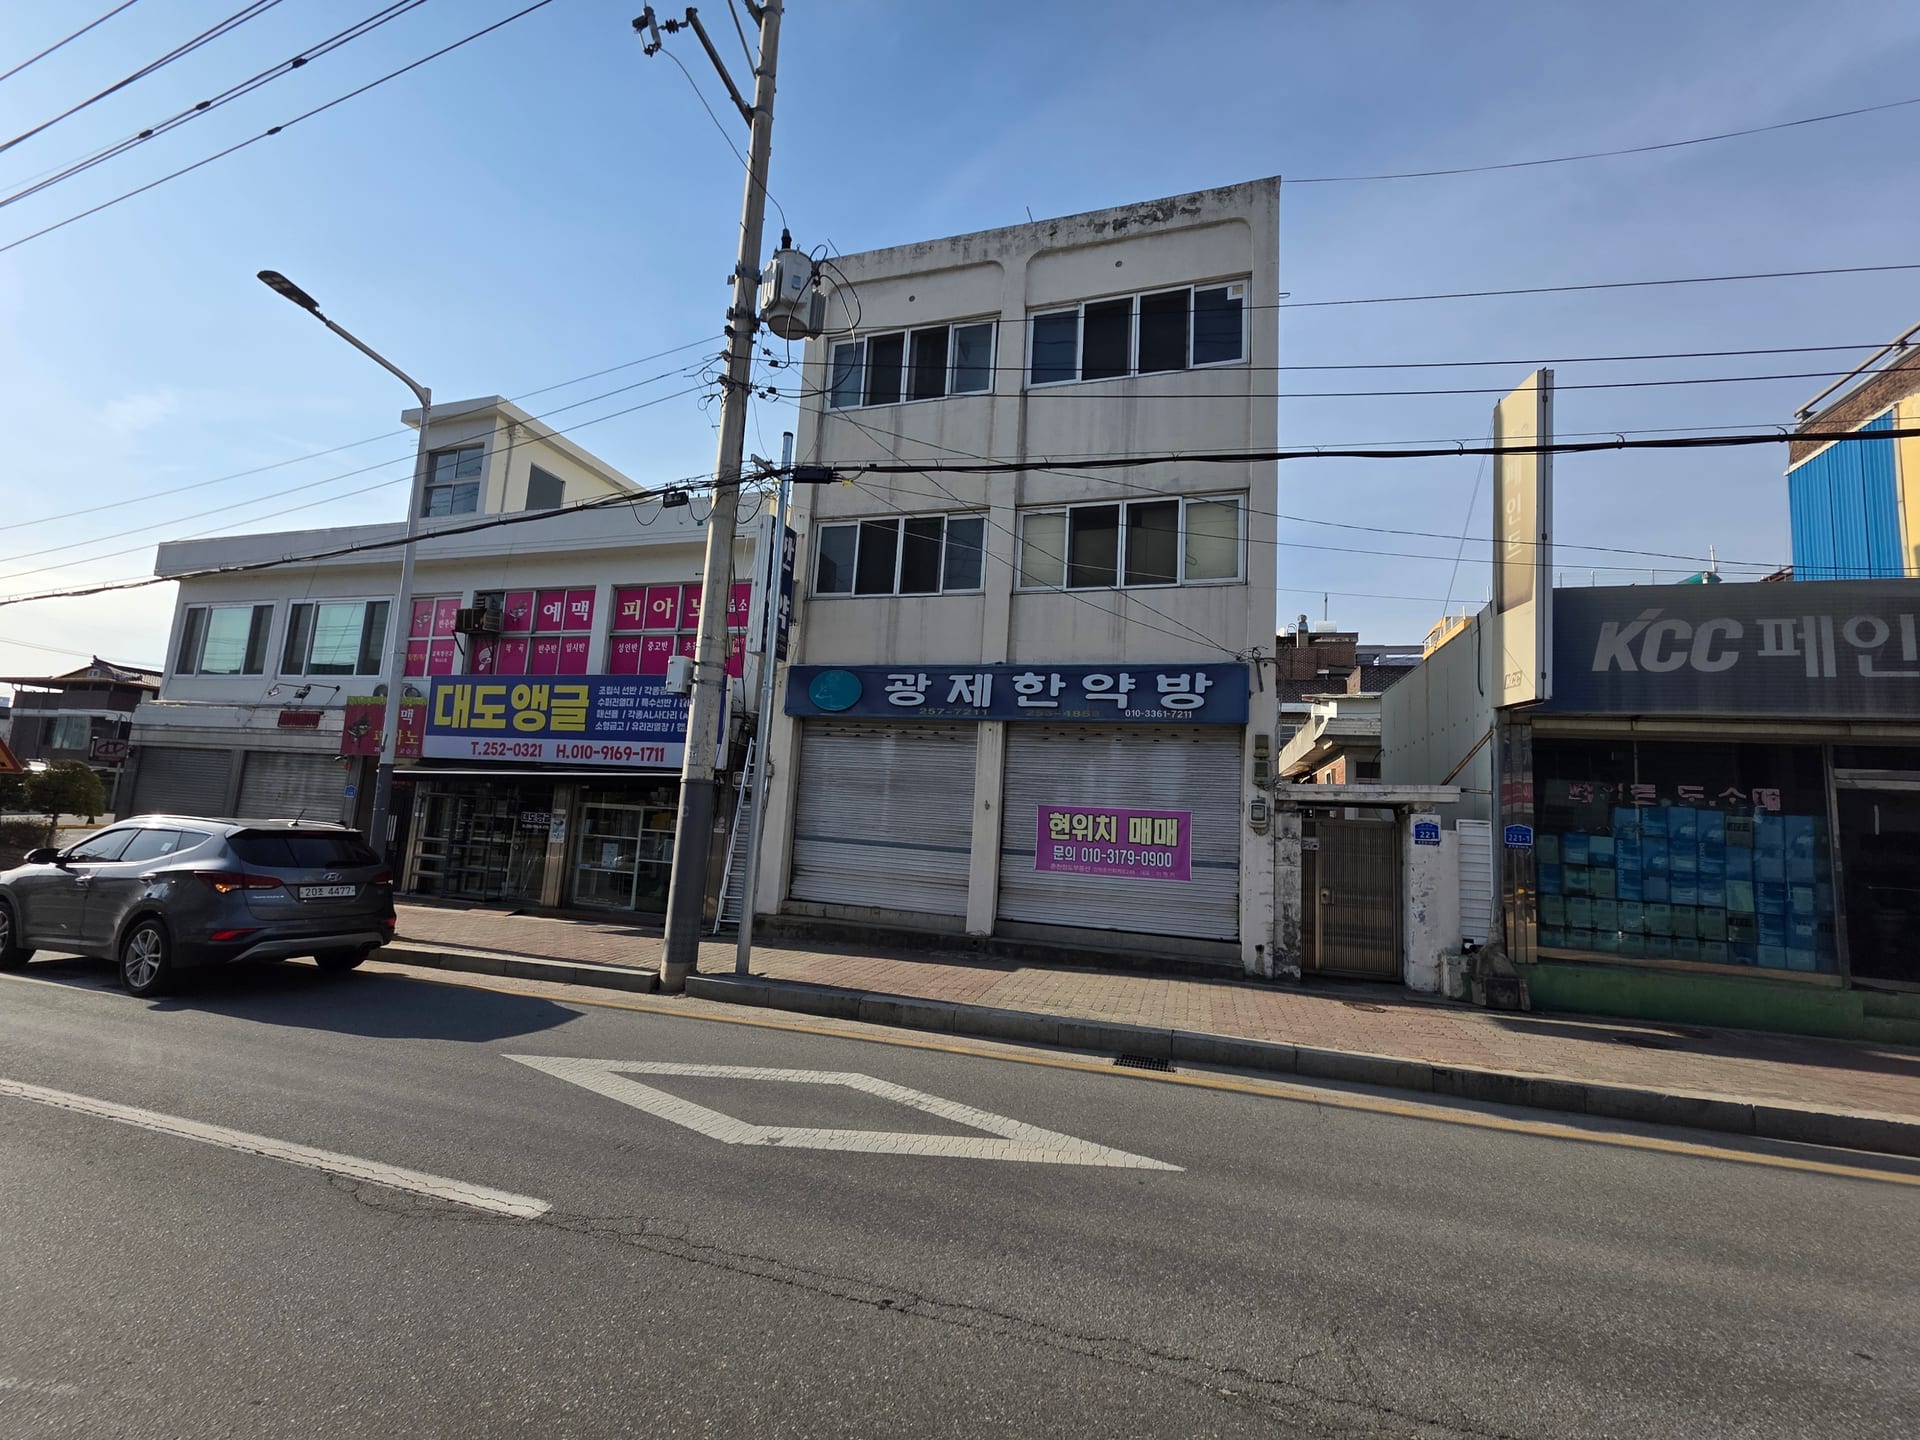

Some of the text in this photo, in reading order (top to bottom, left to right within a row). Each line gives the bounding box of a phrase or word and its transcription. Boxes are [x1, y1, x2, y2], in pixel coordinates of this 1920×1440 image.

[543, 601, 590, 622] 예맥
[1592, 608, 1744, 672] KCC
[622, 686, 638, 696] 선반
[884, 672, 1213, 710] 광제한약방
[434, 684, 590, 732] 대도앵글
[1125, 710, 1193, 718] 010-3361-7211
[595, 721, 625, 731] 소형금고
[471, 741, 665, 762] T.252-0321 H.010-9169-1711
[1049, 812, 1178, 847] 현위치 매매
[1420, 831, 1436, 839] 221
[1508, 833, 1530, 842] 221-1
[1053, 845, 1172, 867] 문의 010-3179-0900
[328, 887, 351, 896] 4477
